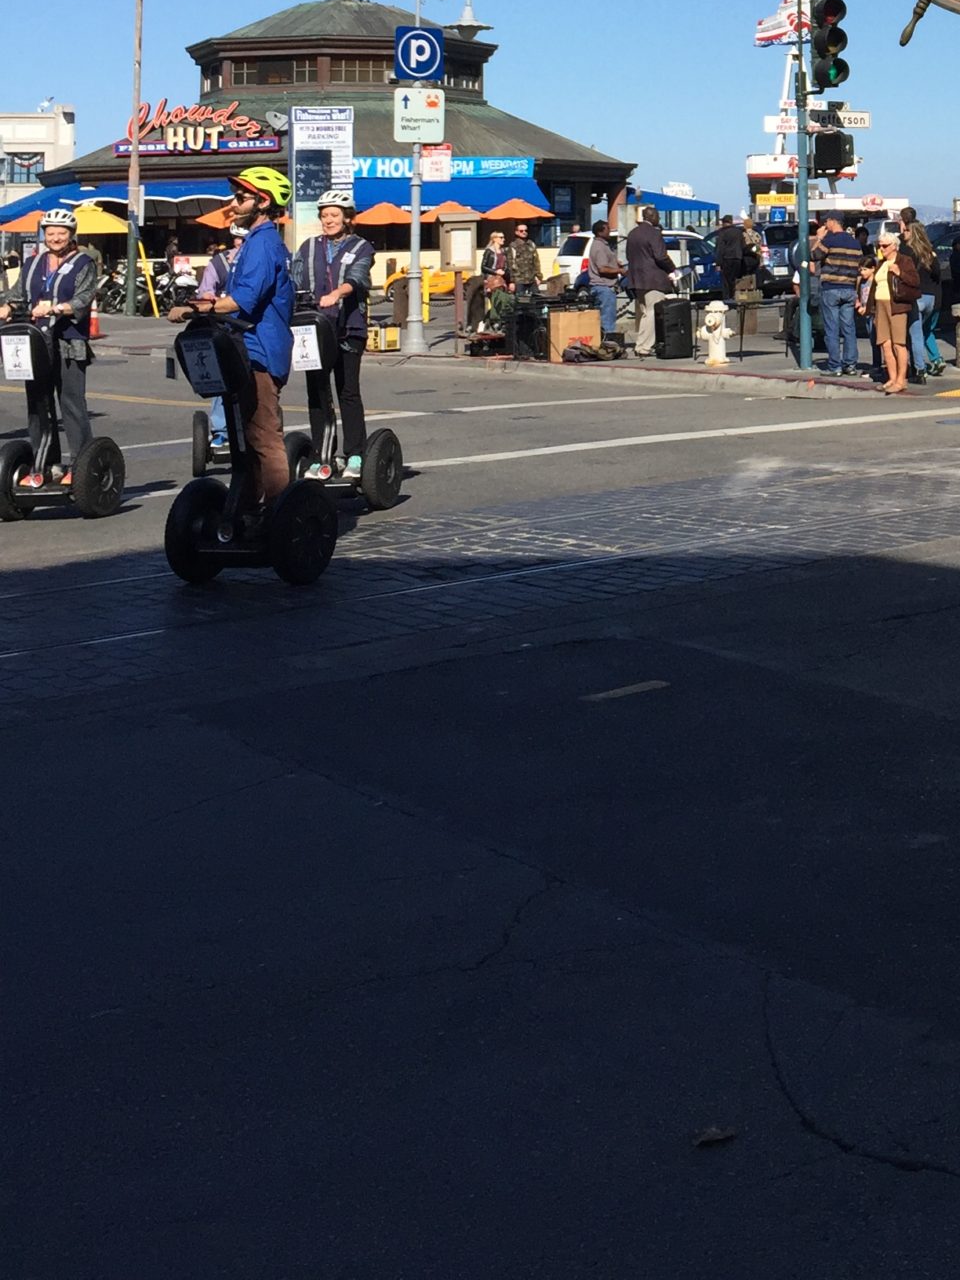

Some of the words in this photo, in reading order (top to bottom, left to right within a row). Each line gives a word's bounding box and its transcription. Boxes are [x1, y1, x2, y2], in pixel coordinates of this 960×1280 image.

[127, 98, 261, 141] Chowder
[816, 114, 866, 125] Jefferson
[166, 125, 225, 151] HUT
[228, 140, 274, 148] GRILL
